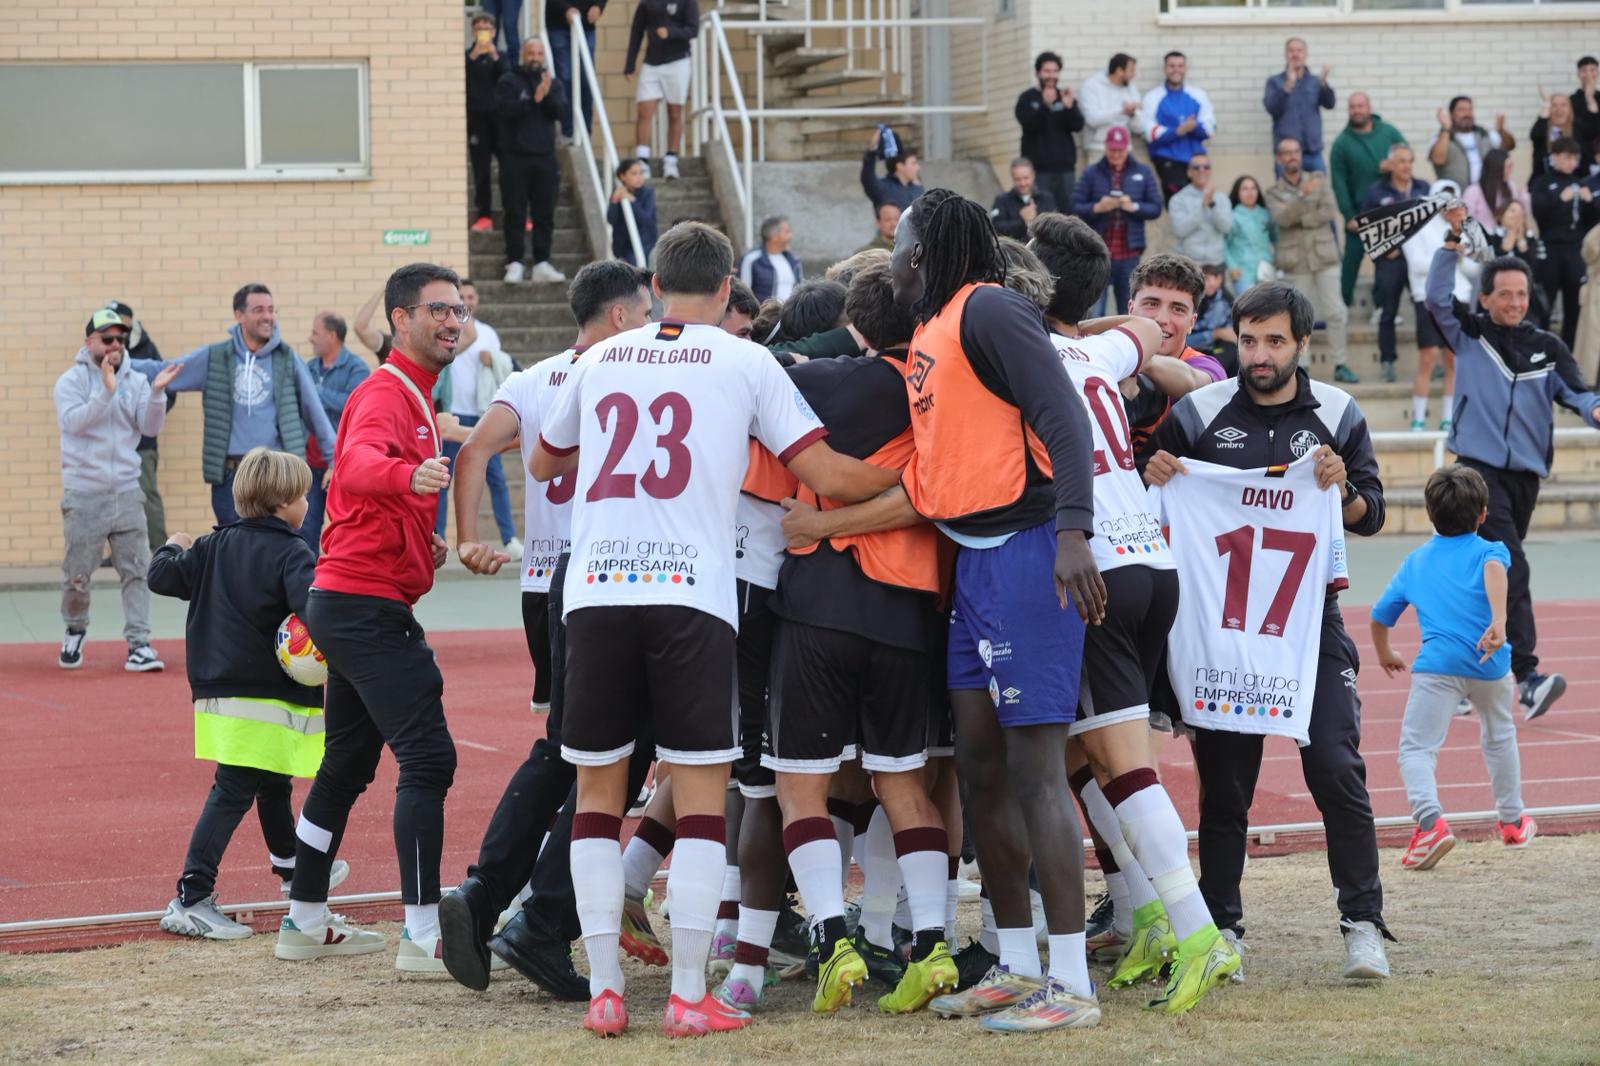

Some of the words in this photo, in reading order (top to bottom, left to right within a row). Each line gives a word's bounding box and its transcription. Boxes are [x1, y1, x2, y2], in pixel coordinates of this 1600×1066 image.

[600, 346, 633, 363] JAVI
[637, 348, 711, 364] DELGADO
[586, 391, 692, 502] 23
[1216, 440, 1245, 449] umbro
[1241, 487, 1294, 511] DAVO
[590, 537, 630, 555] nani
[637, 541, 698, 560] grupo
[587, 559, 697, 575] EMPRESARIAL
[1215, 524, 1317, 638] 17
[1195, 667, 1238, 685] nani
[1243, 673, 1299, 692] grupo
[1194, 686, 1295, 708] EMPRESARIAL
